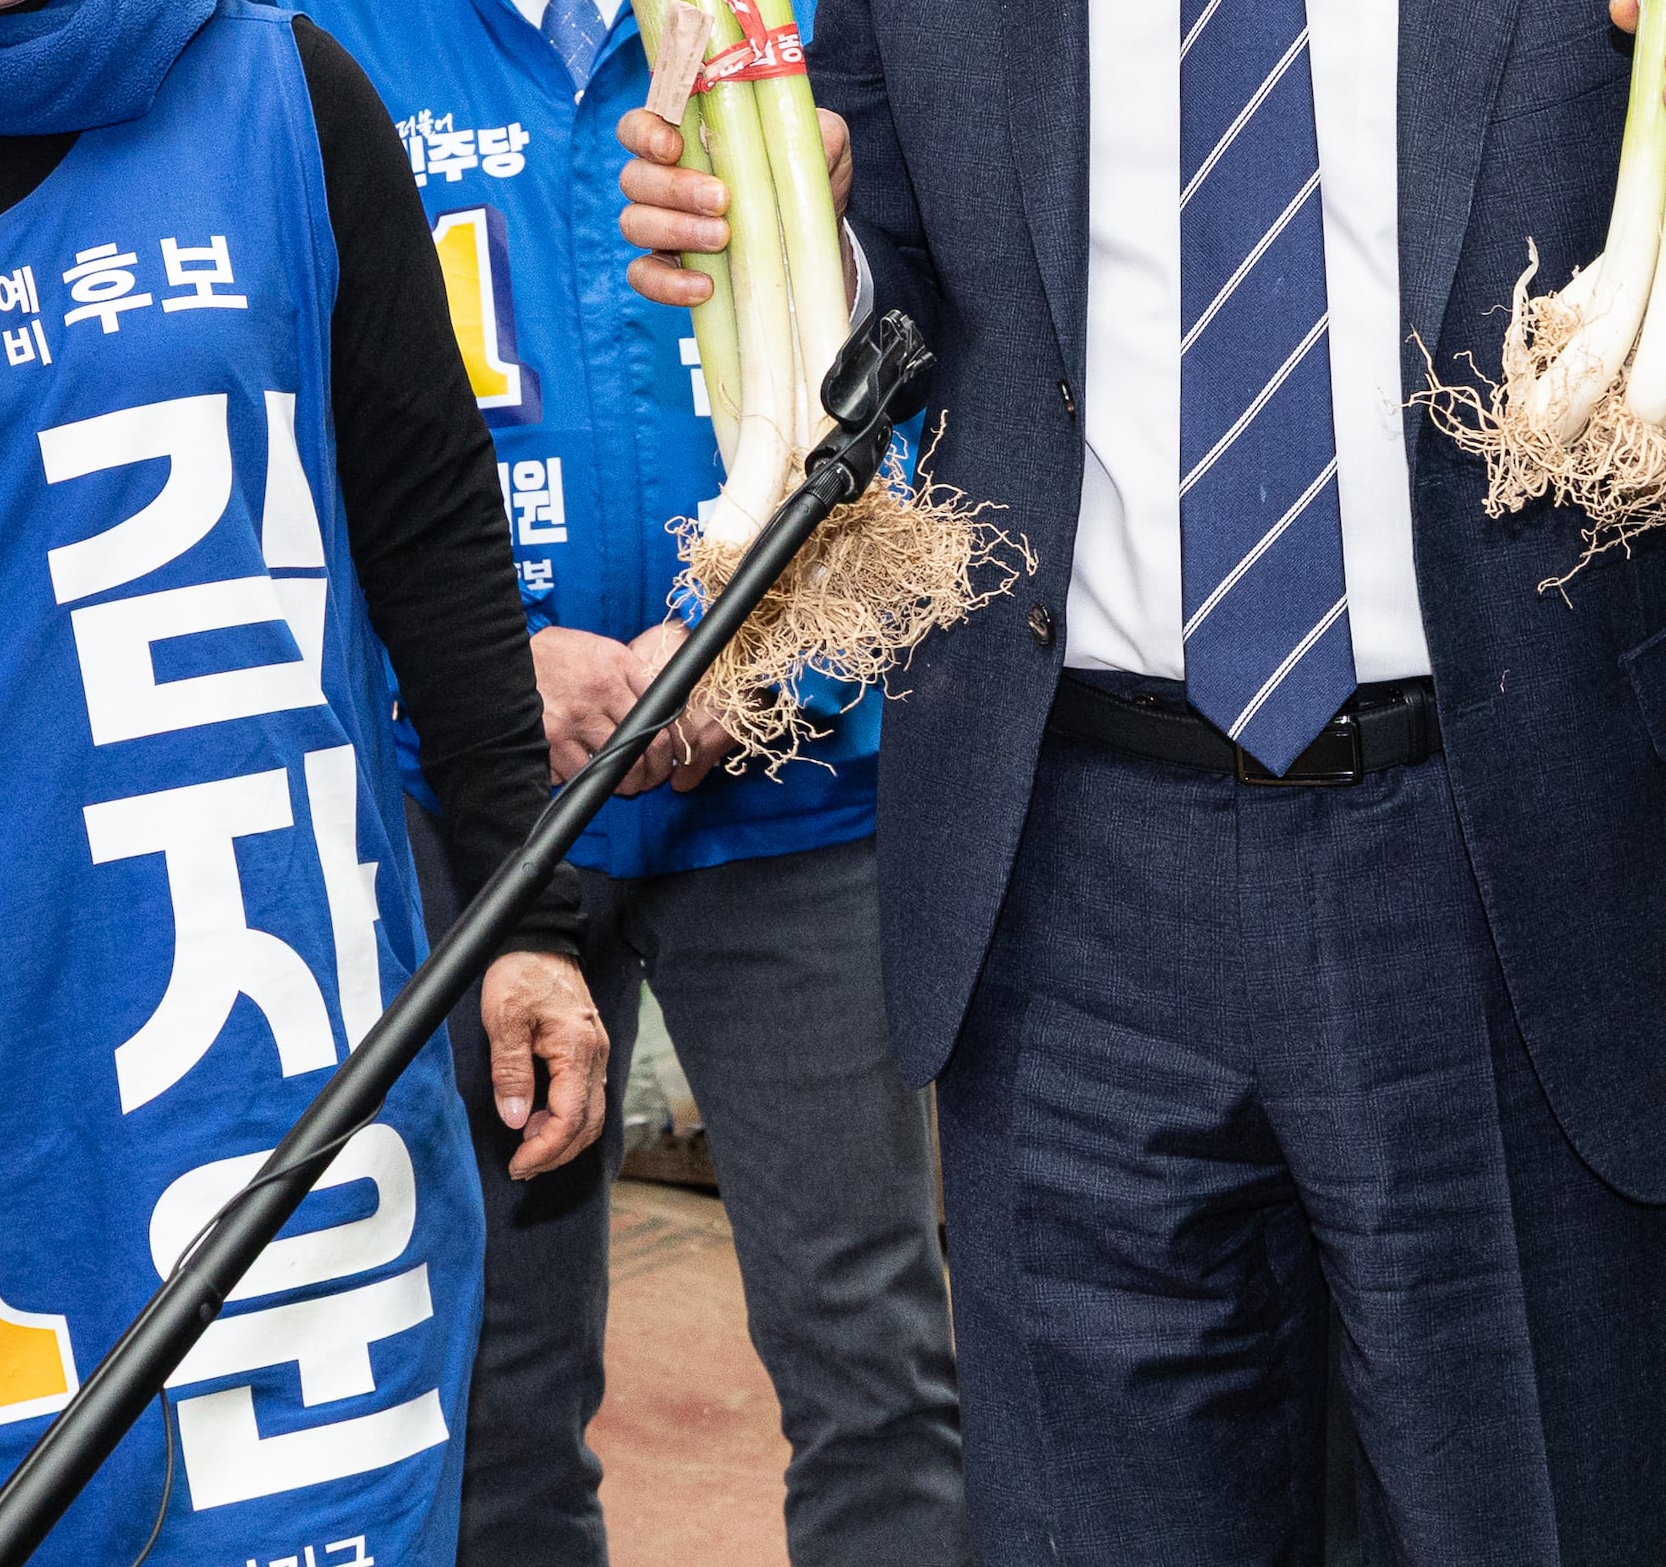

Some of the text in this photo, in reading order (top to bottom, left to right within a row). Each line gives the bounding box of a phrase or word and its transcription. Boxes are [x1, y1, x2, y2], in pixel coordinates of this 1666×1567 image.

[62, 235, 249, 334] 후보
[432, 205, 538, 423] 1
[497, 457, 569, 547] 원
[515, 558, 555, 591] 보
[37, 390, 449, 1511] 김자운
